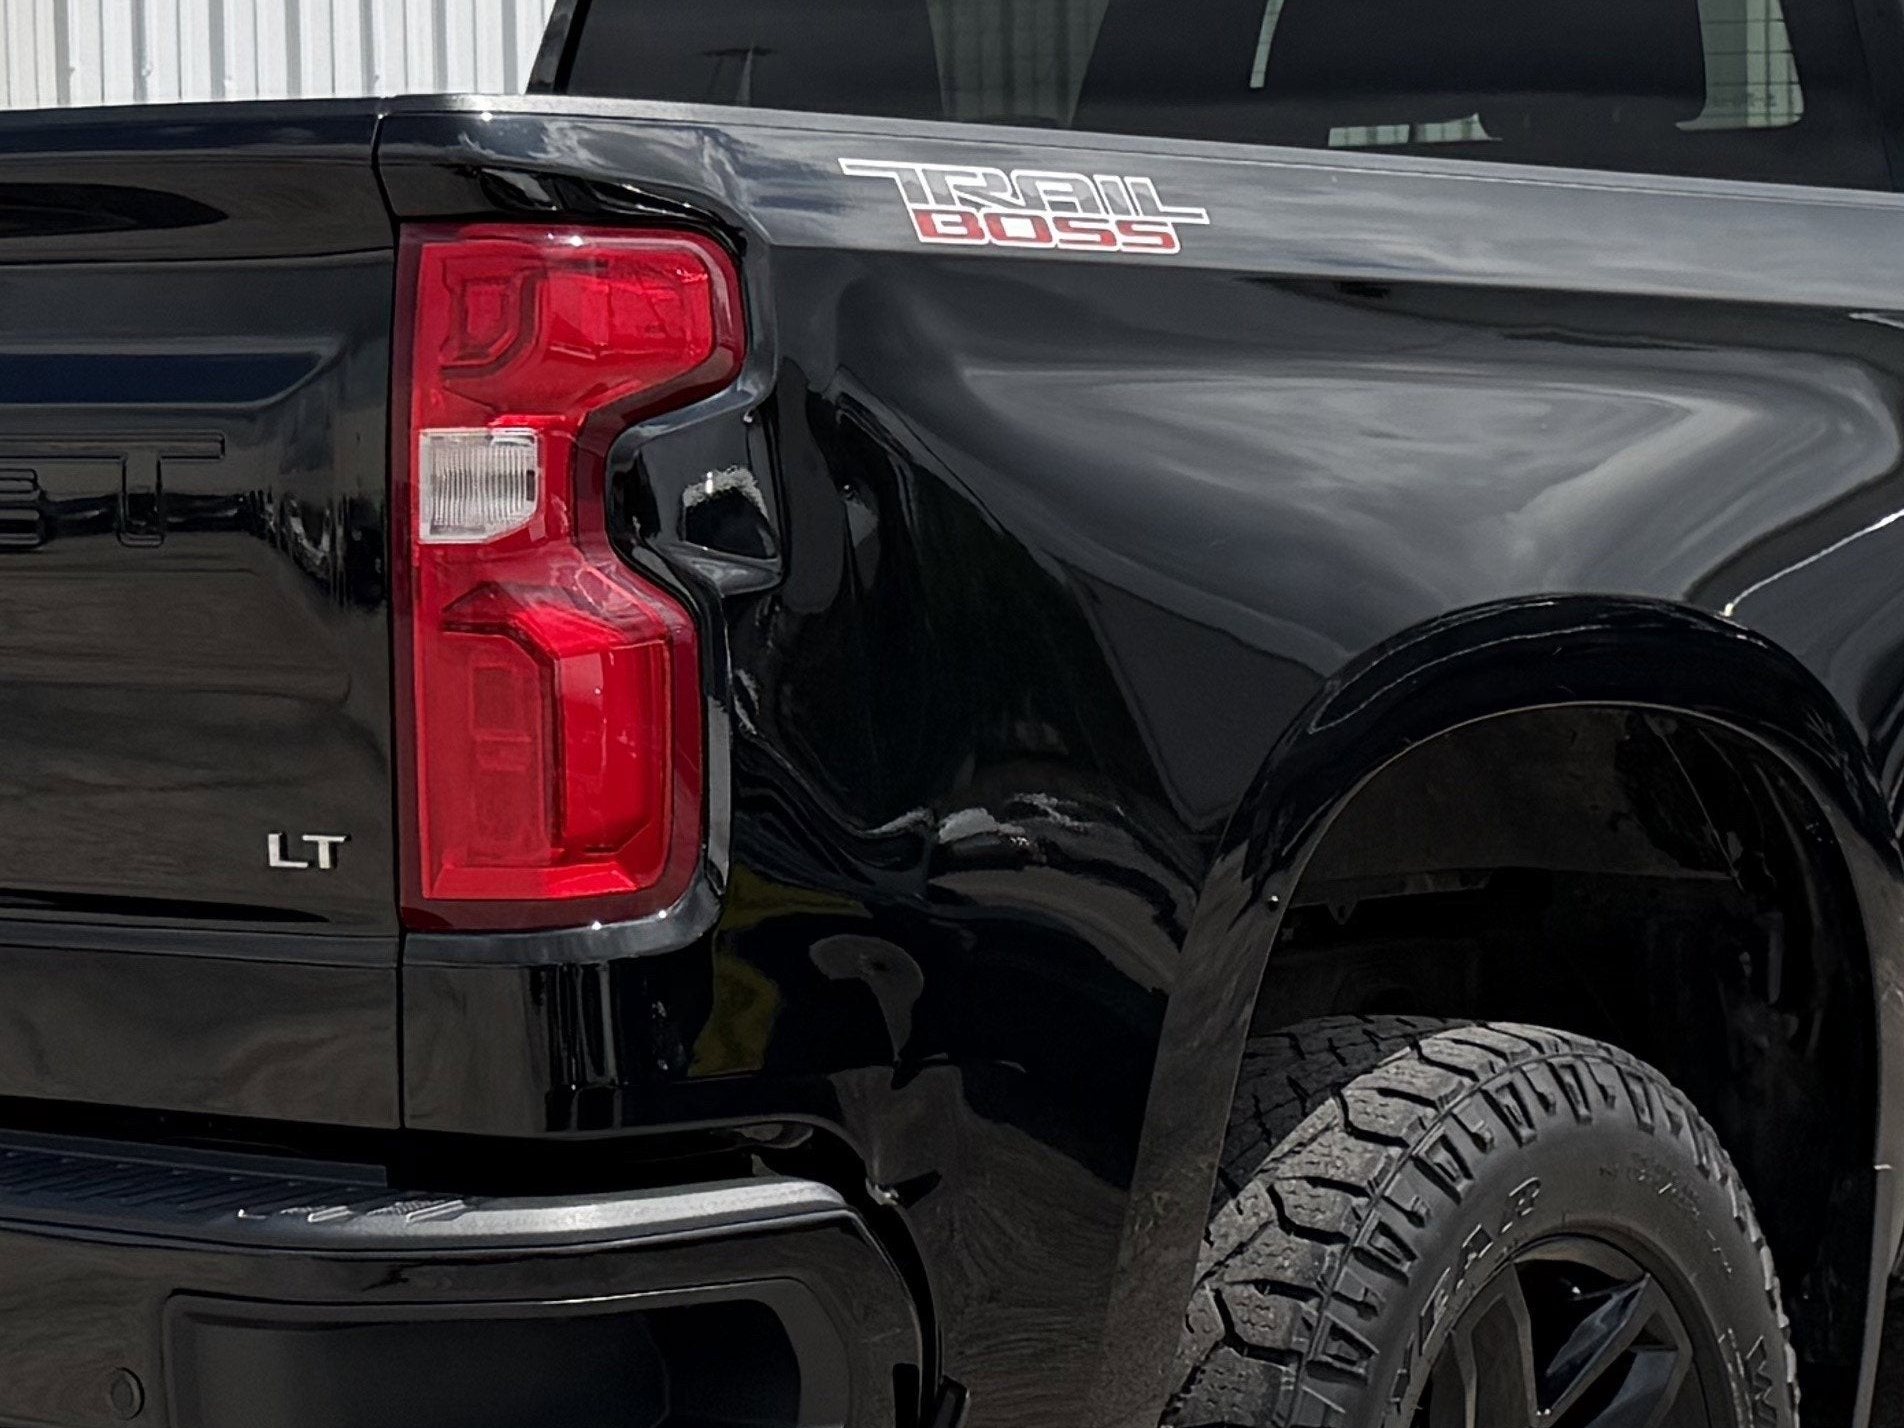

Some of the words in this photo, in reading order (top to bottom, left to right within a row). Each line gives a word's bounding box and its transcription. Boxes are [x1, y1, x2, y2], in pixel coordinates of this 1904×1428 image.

[838, 158, 1210, 225] TRAIL
[908, 206, 1182, 254] BOSS
[267, 832, 348, 870] LT
